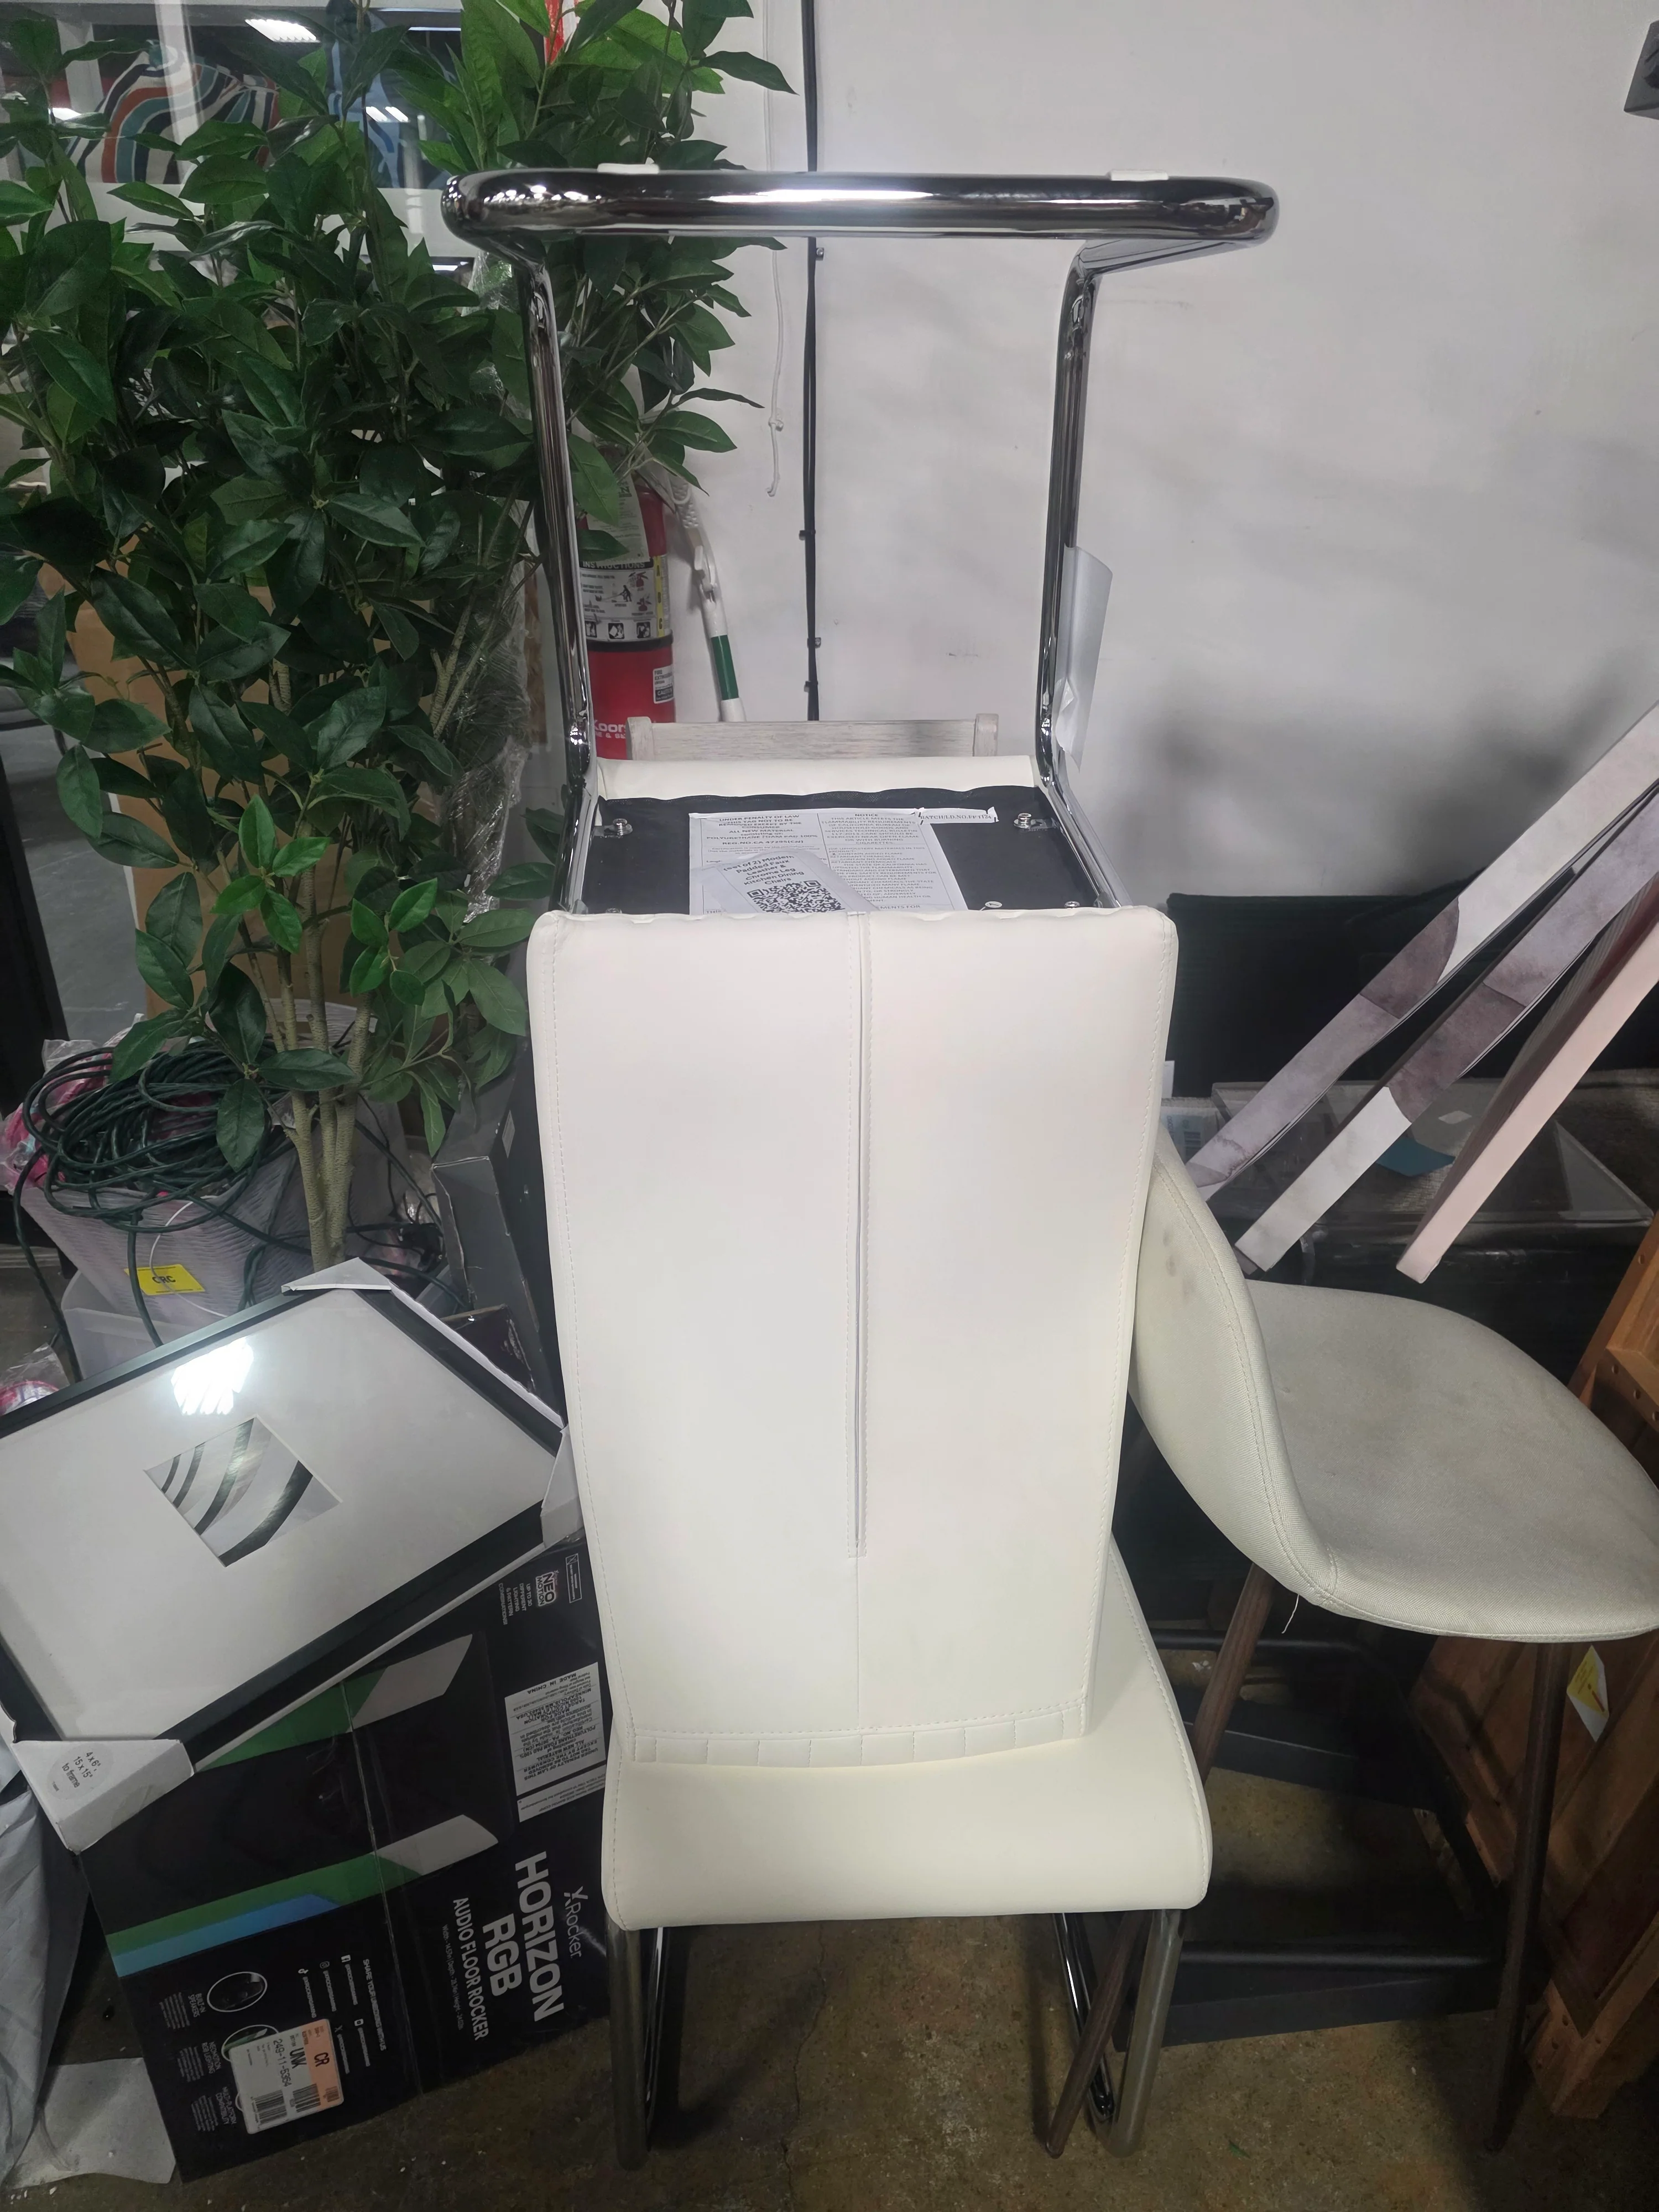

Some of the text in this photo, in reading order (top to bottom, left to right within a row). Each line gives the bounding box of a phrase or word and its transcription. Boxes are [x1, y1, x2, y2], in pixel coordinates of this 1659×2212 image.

[735, 863, 769, 874] Padded
[745, 870, 779, 880] Chrome
[747, 865, 778, 875] Leather
[744, 875, 776, 885] Kitchen
[536, 1577, 545, 1605] MOTION
[542, 1573, 555, 1603] NEO
[560, 1673, 576, 1682] MADE
[527, 1684, 546, 1694] CHINA
[74, 1756, 83, 1765] 15
[62, 1762, 80, 1788] to frame
[514, 1851, 564, 2021] HORIZON
[482, 1913, 523, 1996] RGB
[452, 1897, 490, 2041] AUDIO FLOOR ROCKER
[273, 2038, 291, 2087] 249-11-5364
[289, 2047, 307, 2069] UNK
[313, 2052, 330, 2067] CR
